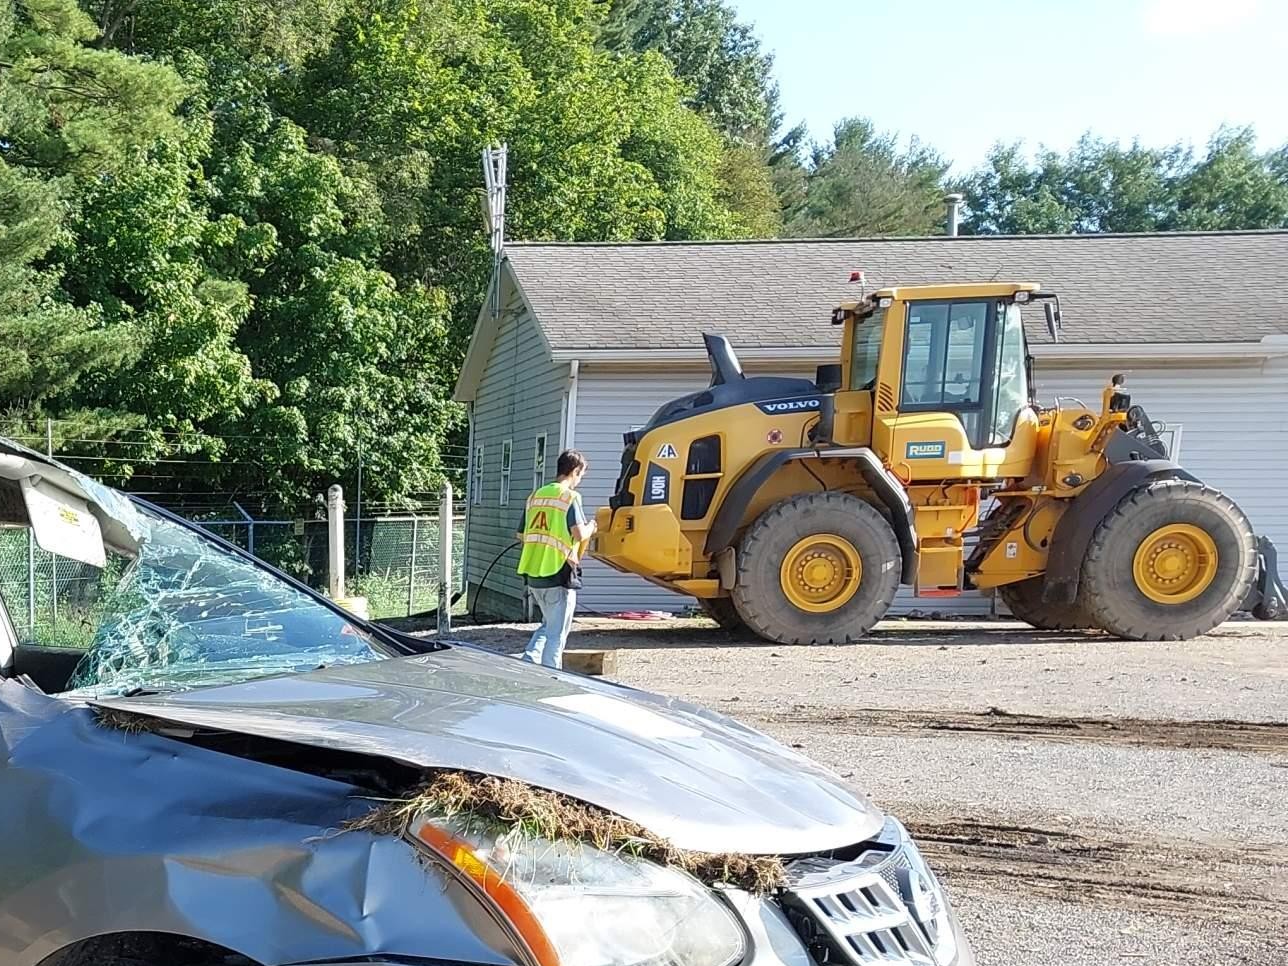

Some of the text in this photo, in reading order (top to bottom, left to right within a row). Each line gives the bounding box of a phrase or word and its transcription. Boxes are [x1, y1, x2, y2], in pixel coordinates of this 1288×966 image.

[763, 399, 820, 411] VOLVO
[909, 444, 943, 456] RUDD
[650, 475, 666, 500] L90H
